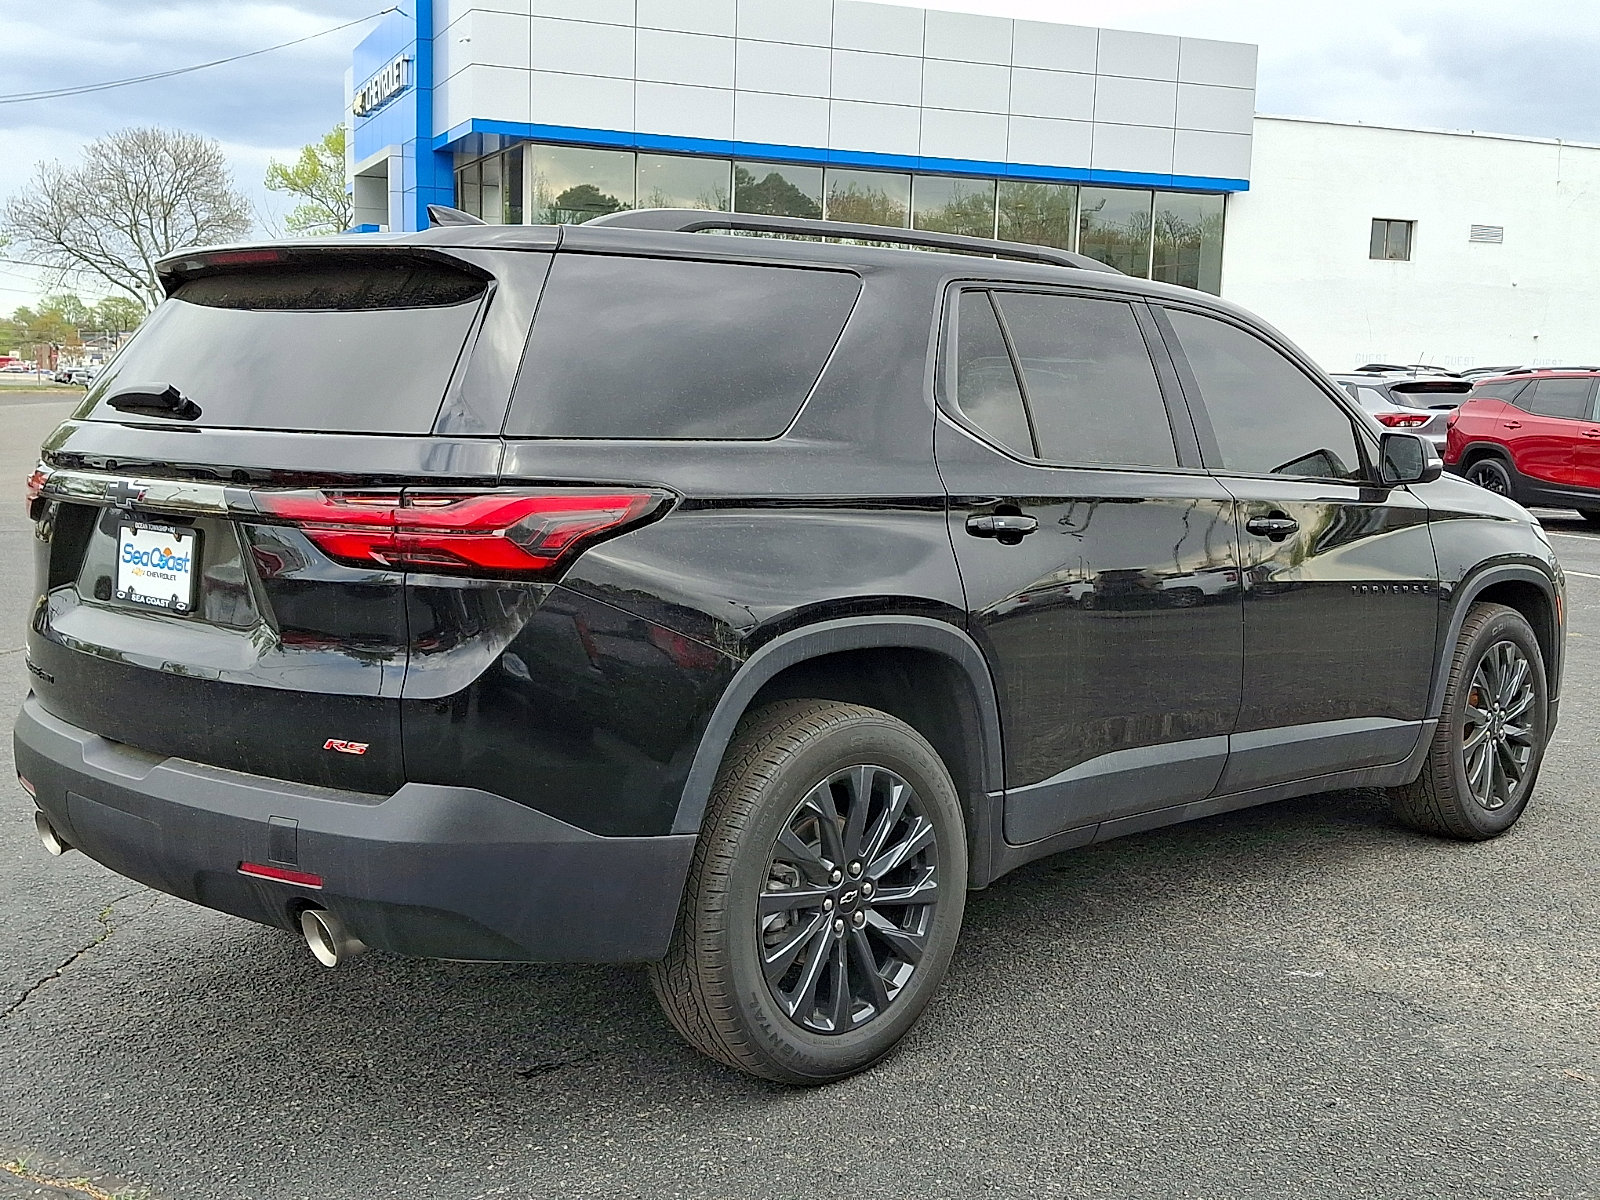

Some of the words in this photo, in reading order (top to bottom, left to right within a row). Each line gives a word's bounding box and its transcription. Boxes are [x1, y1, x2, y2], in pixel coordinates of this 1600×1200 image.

[365, 53, 415, 111] CHEVROLET
[146, 570, 177, 581] CHEVROLET
[1351, 584, 1430, 595] TRAVERSE
[131, 593, 145, 604] SEA
[145, 596, 170, 608] COAST
[322, 738, 370, 755] RS
